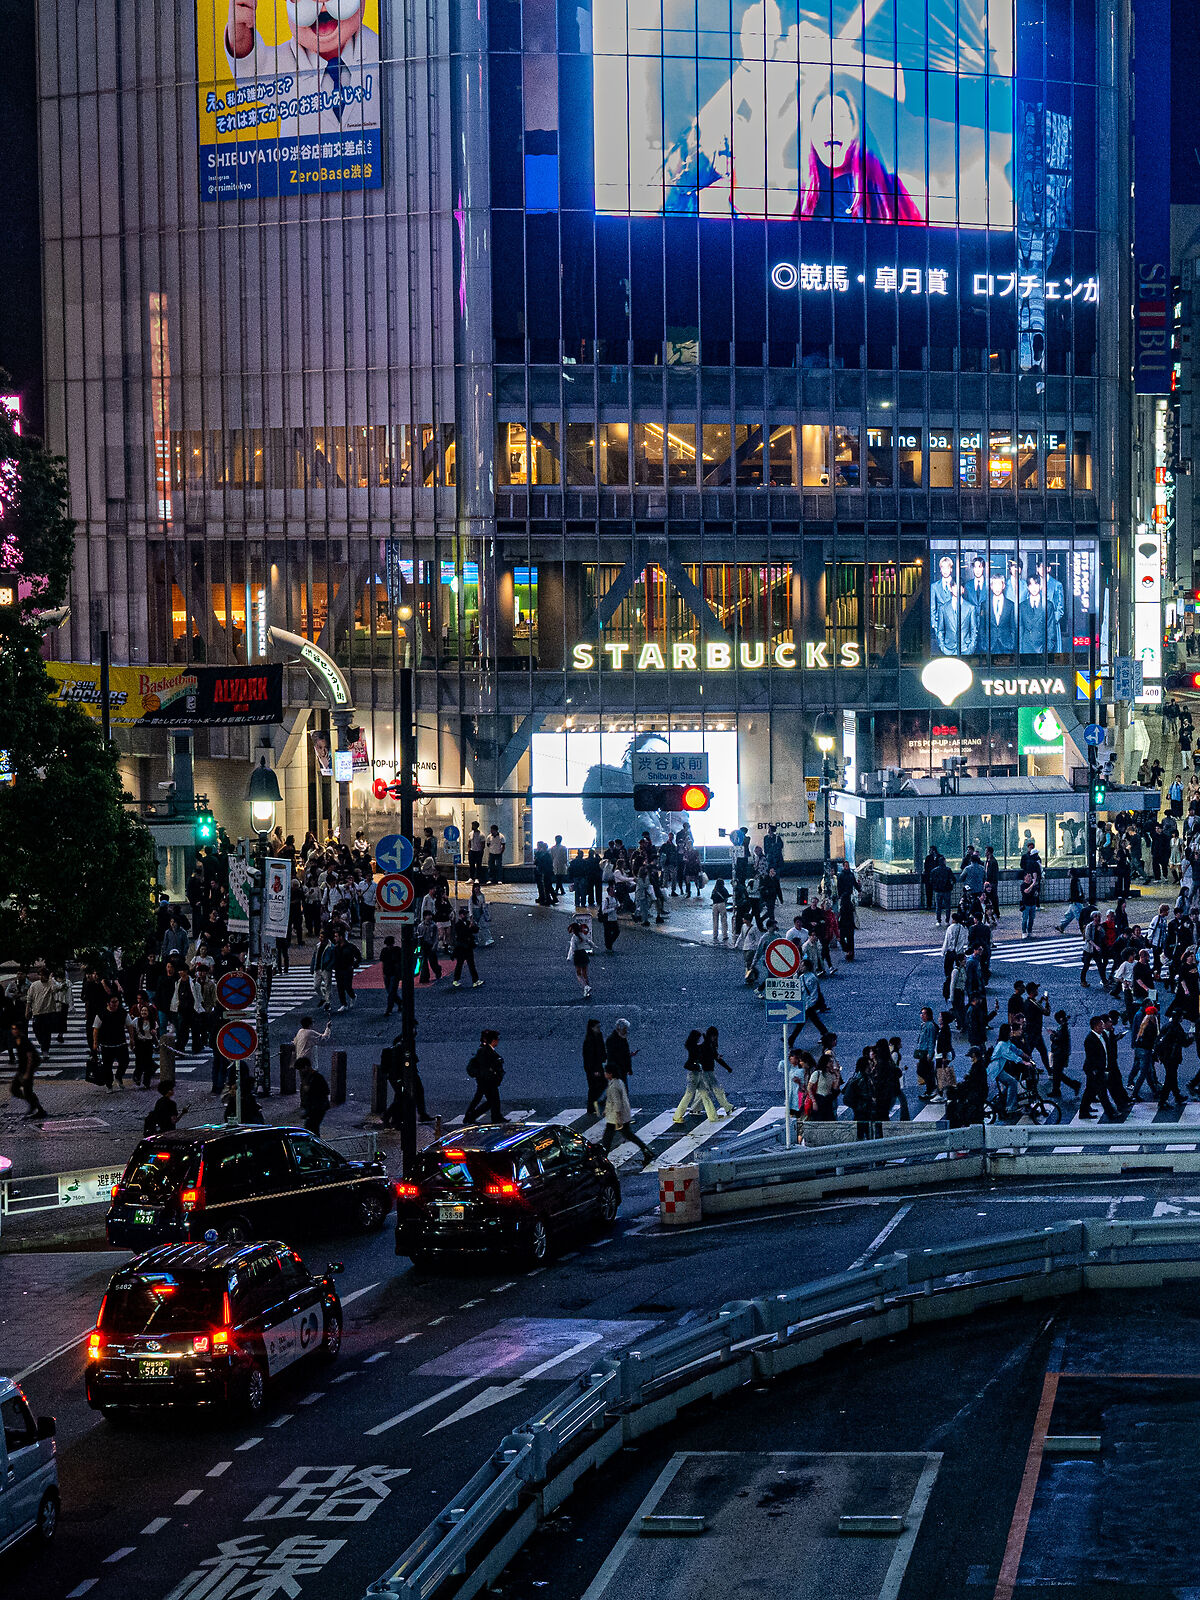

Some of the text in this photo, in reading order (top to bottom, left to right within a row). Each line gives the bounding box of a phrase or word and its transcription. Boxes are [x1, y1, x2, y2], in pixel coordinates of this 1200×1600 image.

[290, 163, 373, 183] ZeroBase渋谷
[1139, 263, 1167, 370] SEIBU
[930, 433, 980, 449] baed
[572, 642, 861, 669] STARBUCKS
[982, 677, 1065, 696] TSUTAYA
[638, 757, 702, 771] 渋谷駅前
[648, 772, 696, 781] Shibuya Sta.
[776, 820, 807, 829] POP-UP
[772, 990, 796, 998] 6-22
